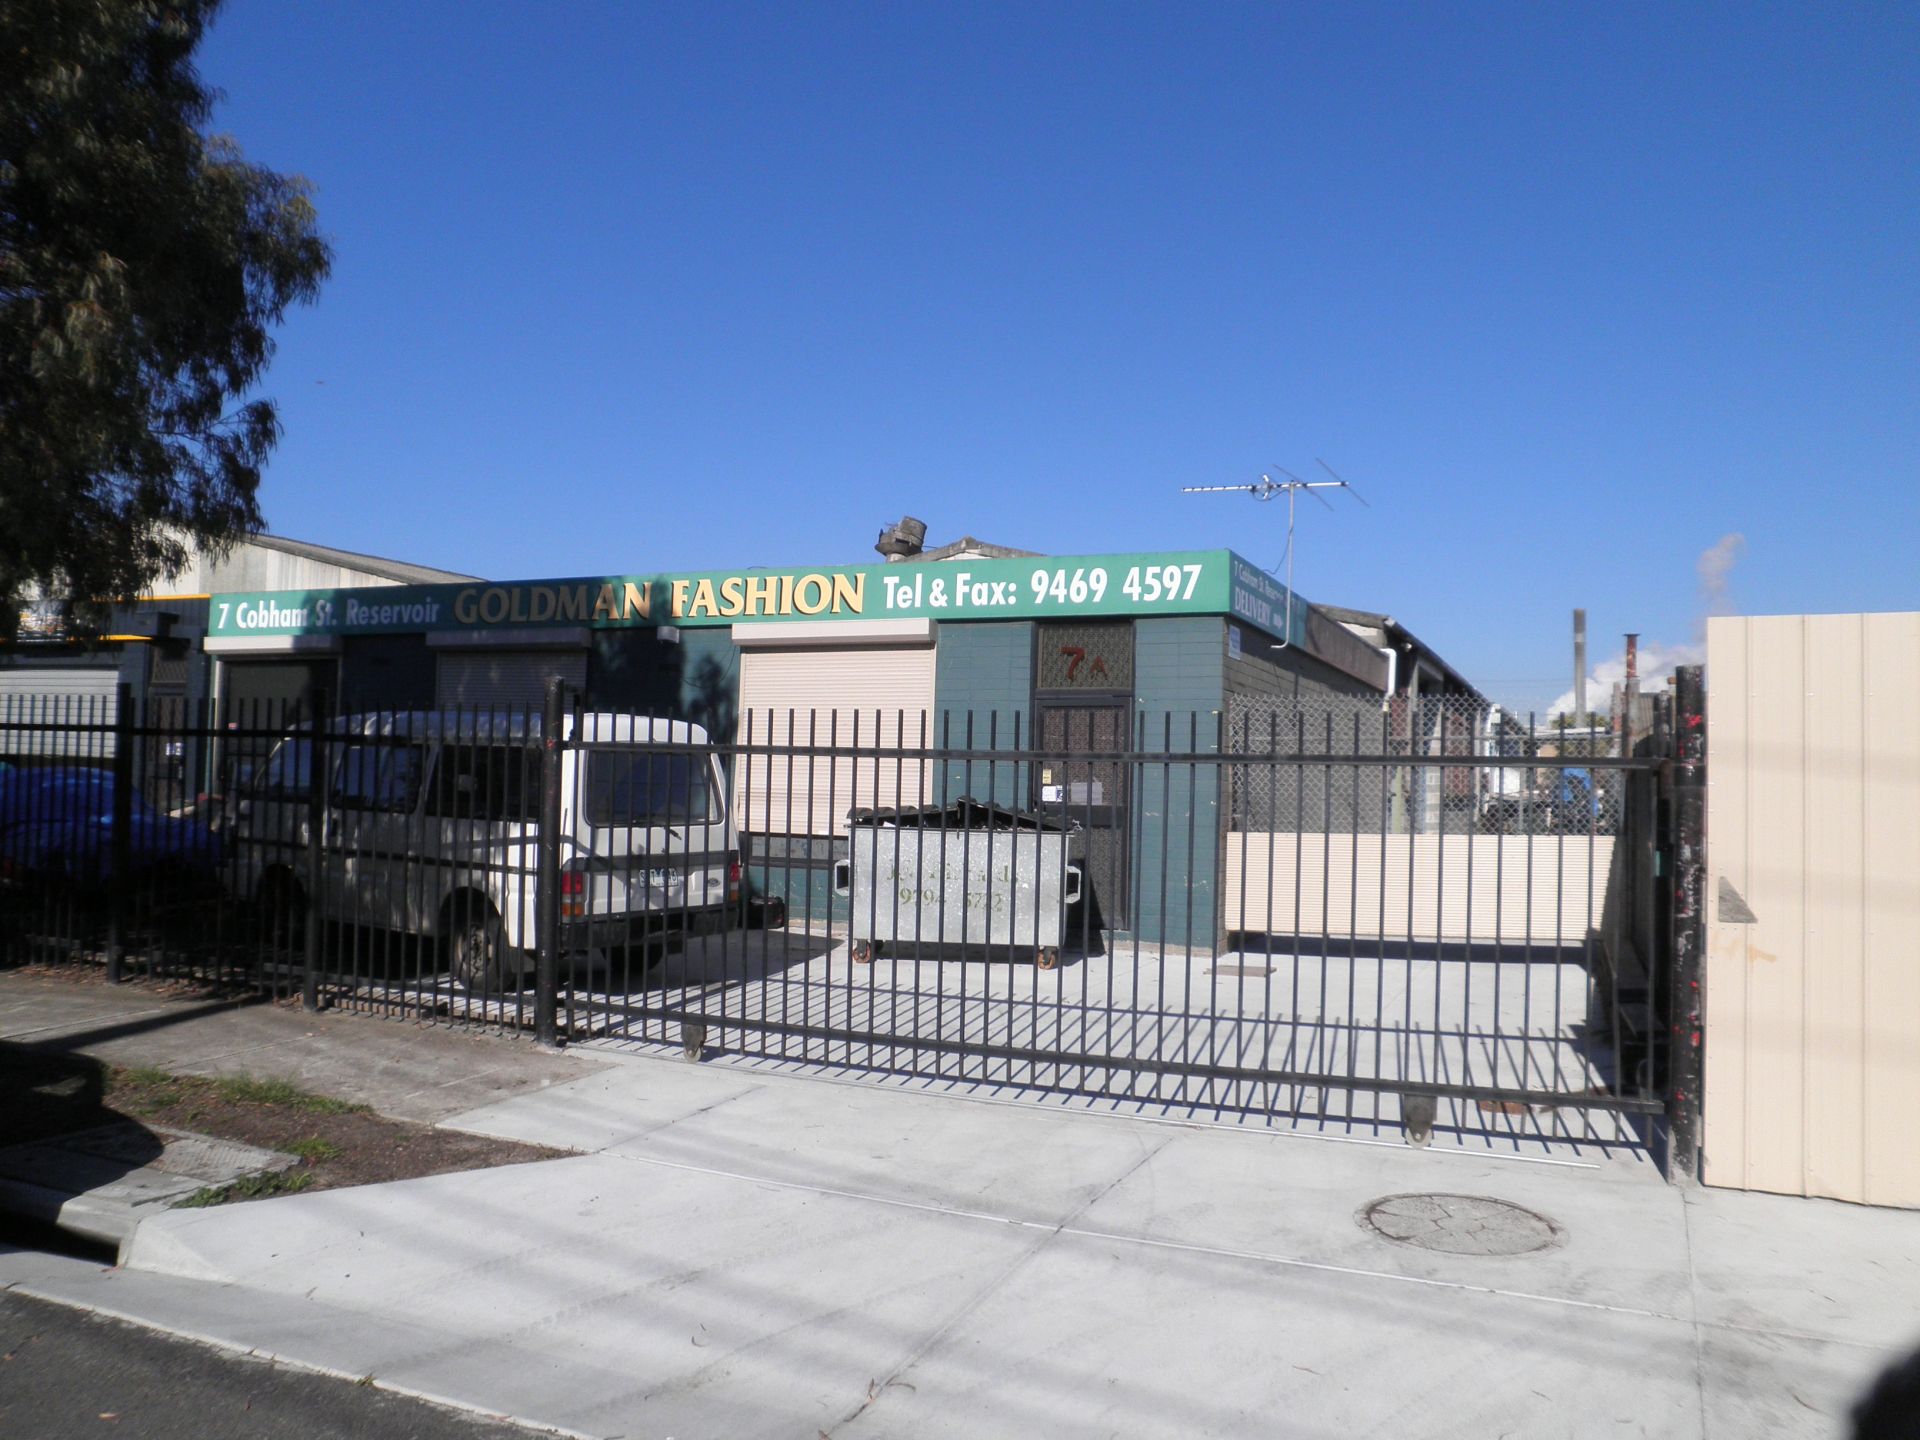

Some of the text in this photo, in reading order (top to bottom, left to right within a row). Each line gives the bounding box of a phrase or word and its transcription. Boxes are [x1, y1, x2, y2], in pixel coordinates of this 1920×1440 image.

[454, 573, 867, 624] GOLDMAN FASHION
[883, 564, 1202, 609] Tel & Fax: 9469 4597
[1234, 586, 1272, 626] DELIVERY
[217, 598, 440, 629] 7 Cobham St. Reservoir
